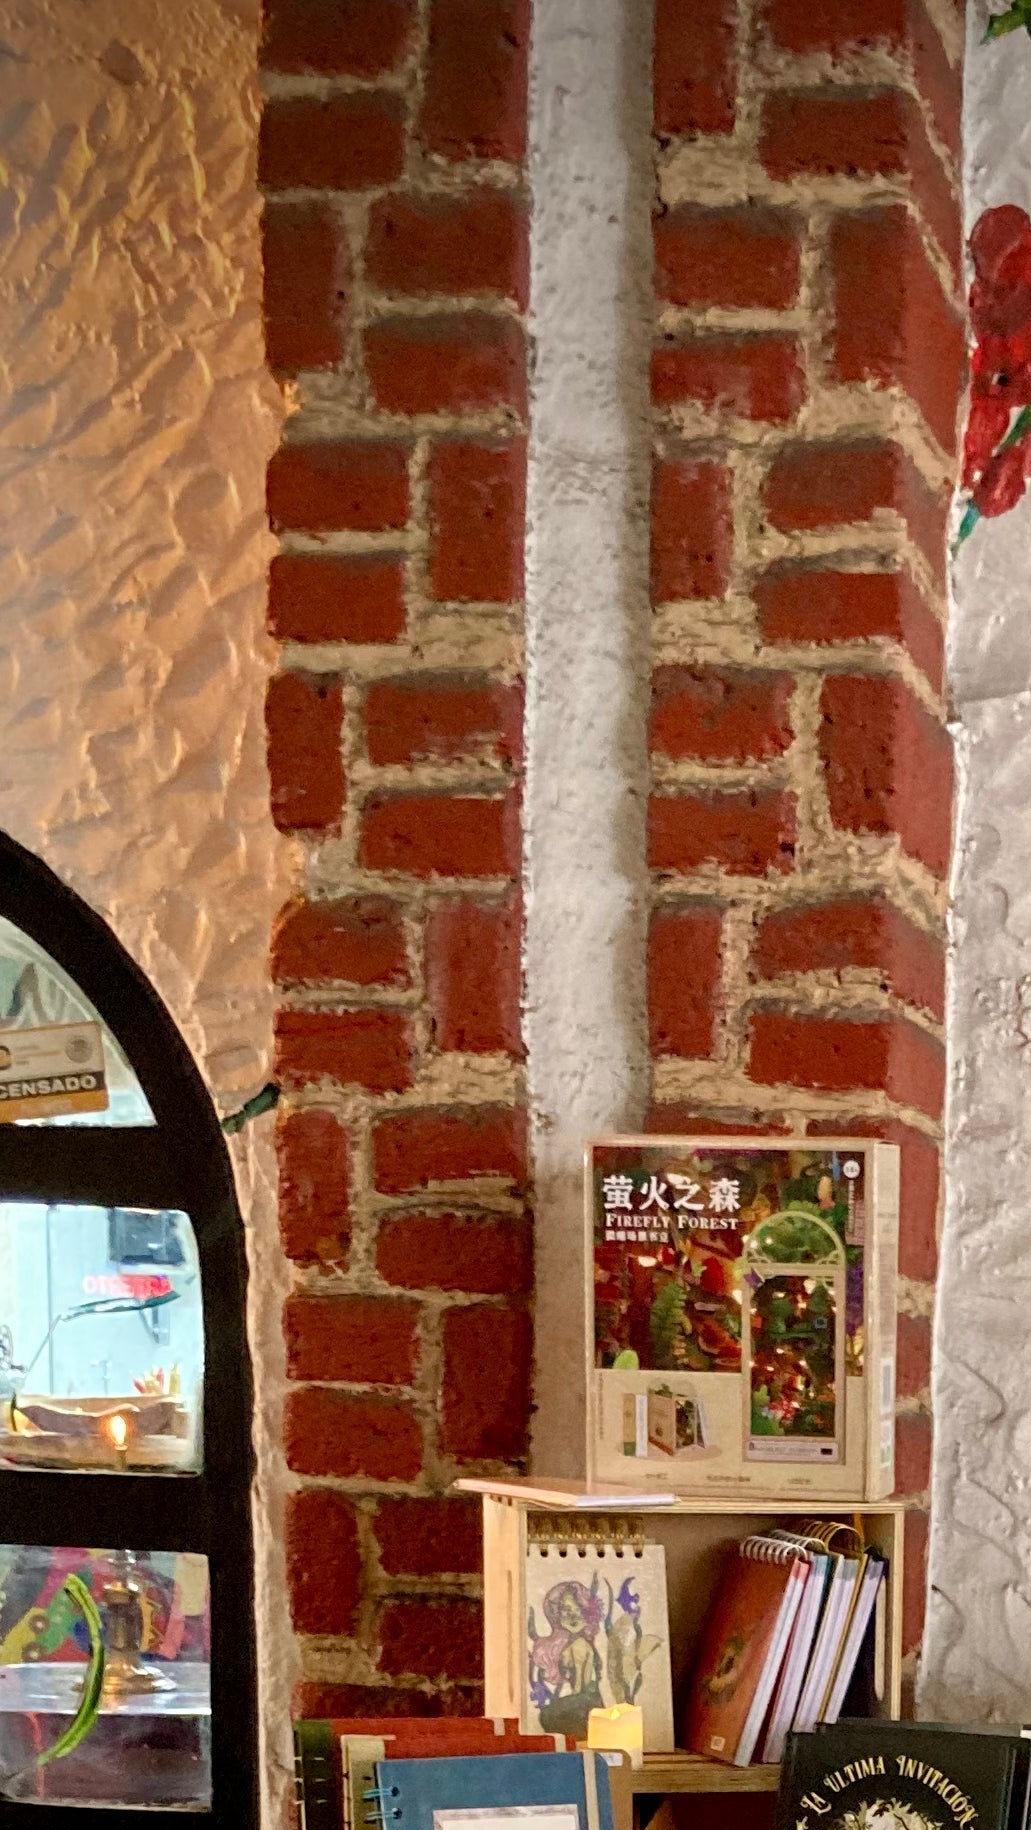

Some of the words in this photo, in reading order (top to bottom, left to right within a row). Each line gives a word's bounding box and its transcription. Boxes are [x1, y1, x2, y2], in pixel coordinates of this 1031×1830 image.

[602, 1174, 741, 1212] 萤火之森
[605, 1212, 670, 1228] FIREFLY
[678, 1215, 739, 1230] FOREST
[800, 1791, 832, 1816] LA
